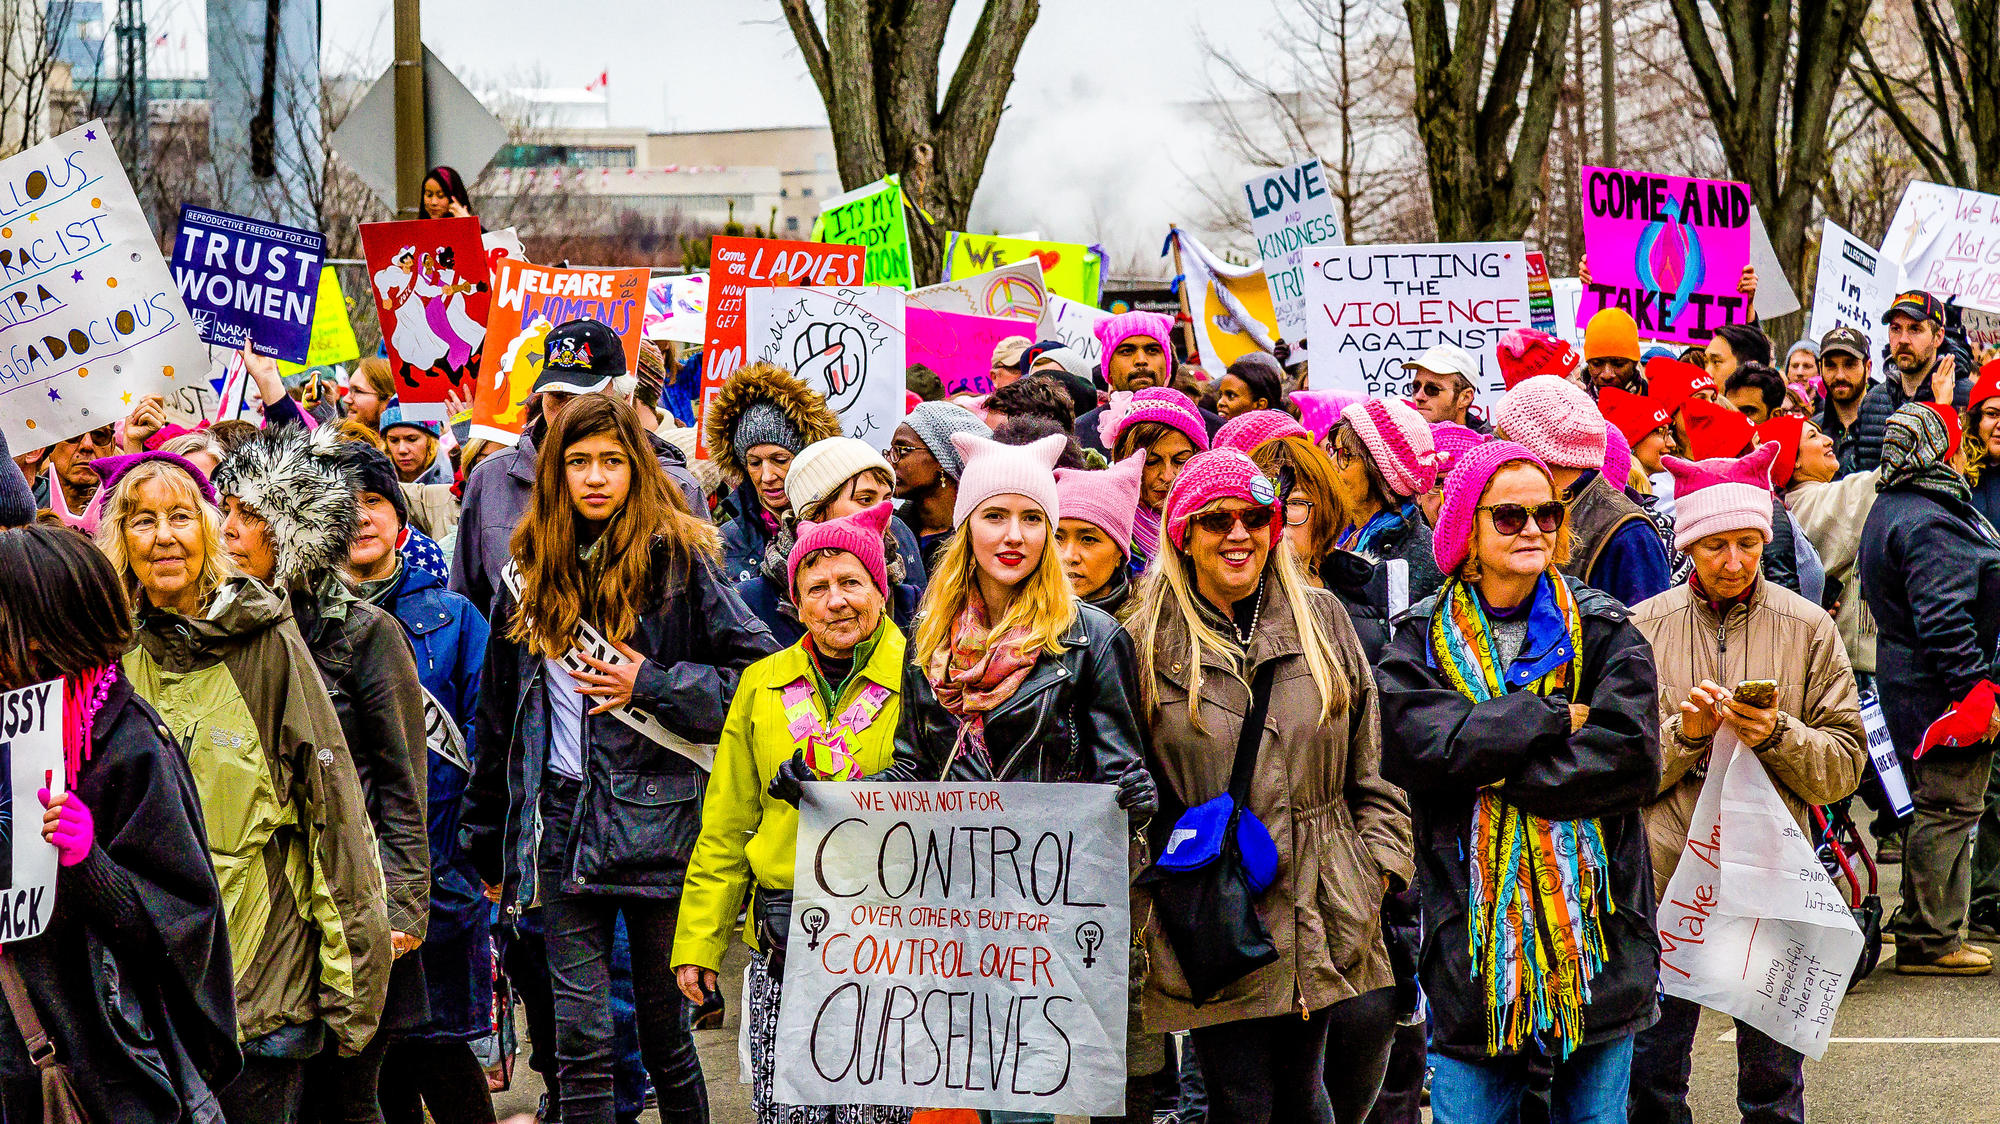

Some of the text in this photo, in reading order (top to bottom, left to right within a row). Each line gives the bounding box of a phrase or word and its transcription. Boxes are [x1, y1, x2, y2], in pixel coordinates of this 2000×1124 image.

[871, 191, 896, 223] MY
[1244, 160, 1326, 219] LOVE
[1588, 171, 1750, 229] COME AND
[187, 211, 318, 247] REPRODUCTIVE FREEDOM FOR ALL
[1285, 210, 1302, 225] AND
[963, 238, 1008, 270] WE
[1257, 214, 1338, 261] KINDNESS
[182, 226, 319, 288] TRUST
[717, 247, 860, 287] Come LADIES
[728, 262, 747, 276] on
[1322, 252, 1501, 282] CUTTING
[176, 266, 312, 326] WOMEN
[497, 265, 638, 312] WELFARE is
[620, 288, 634, 299] a
[717, 298, 742, 312] LET'S
[721, 284, 747, 296] NOW
[1383, 280, 1441, 297] THE
[1840, 274, 1861, 303] I'm
[520, 293, 637, 337] WOMEN'S
[716, 314, 740, 329] GET
[1322, 298, 1522, 328] VIOLENCE
[1588, 282, 1676, 334] TAKE
[1687, 293, 1743, 340] IT
[1837, 301, 1872, 331] with
[216, 322, 253, 340] NARAL
[1338, 327, 1510, 354] AGAINST
[851, 790, 1005, 813] WE WISH NOT FOR
[814, 817, 1108, 908] CONTROL
[850, 904, 1050, 934] OVER OTHERS BUT FOR
[1659, 884, 1719, 980] Make
[822, 932, 1055, 988] CONTROL OVER
[1756, 957, 1787, 999] loving
[1777, 937, 1806, 1009] respectful
[1791, 954, 1822, 1019] tolerant
[1810, 968, 1843, 1027] hopeful
[809, 981, 1074, 1097] OURSELVES
